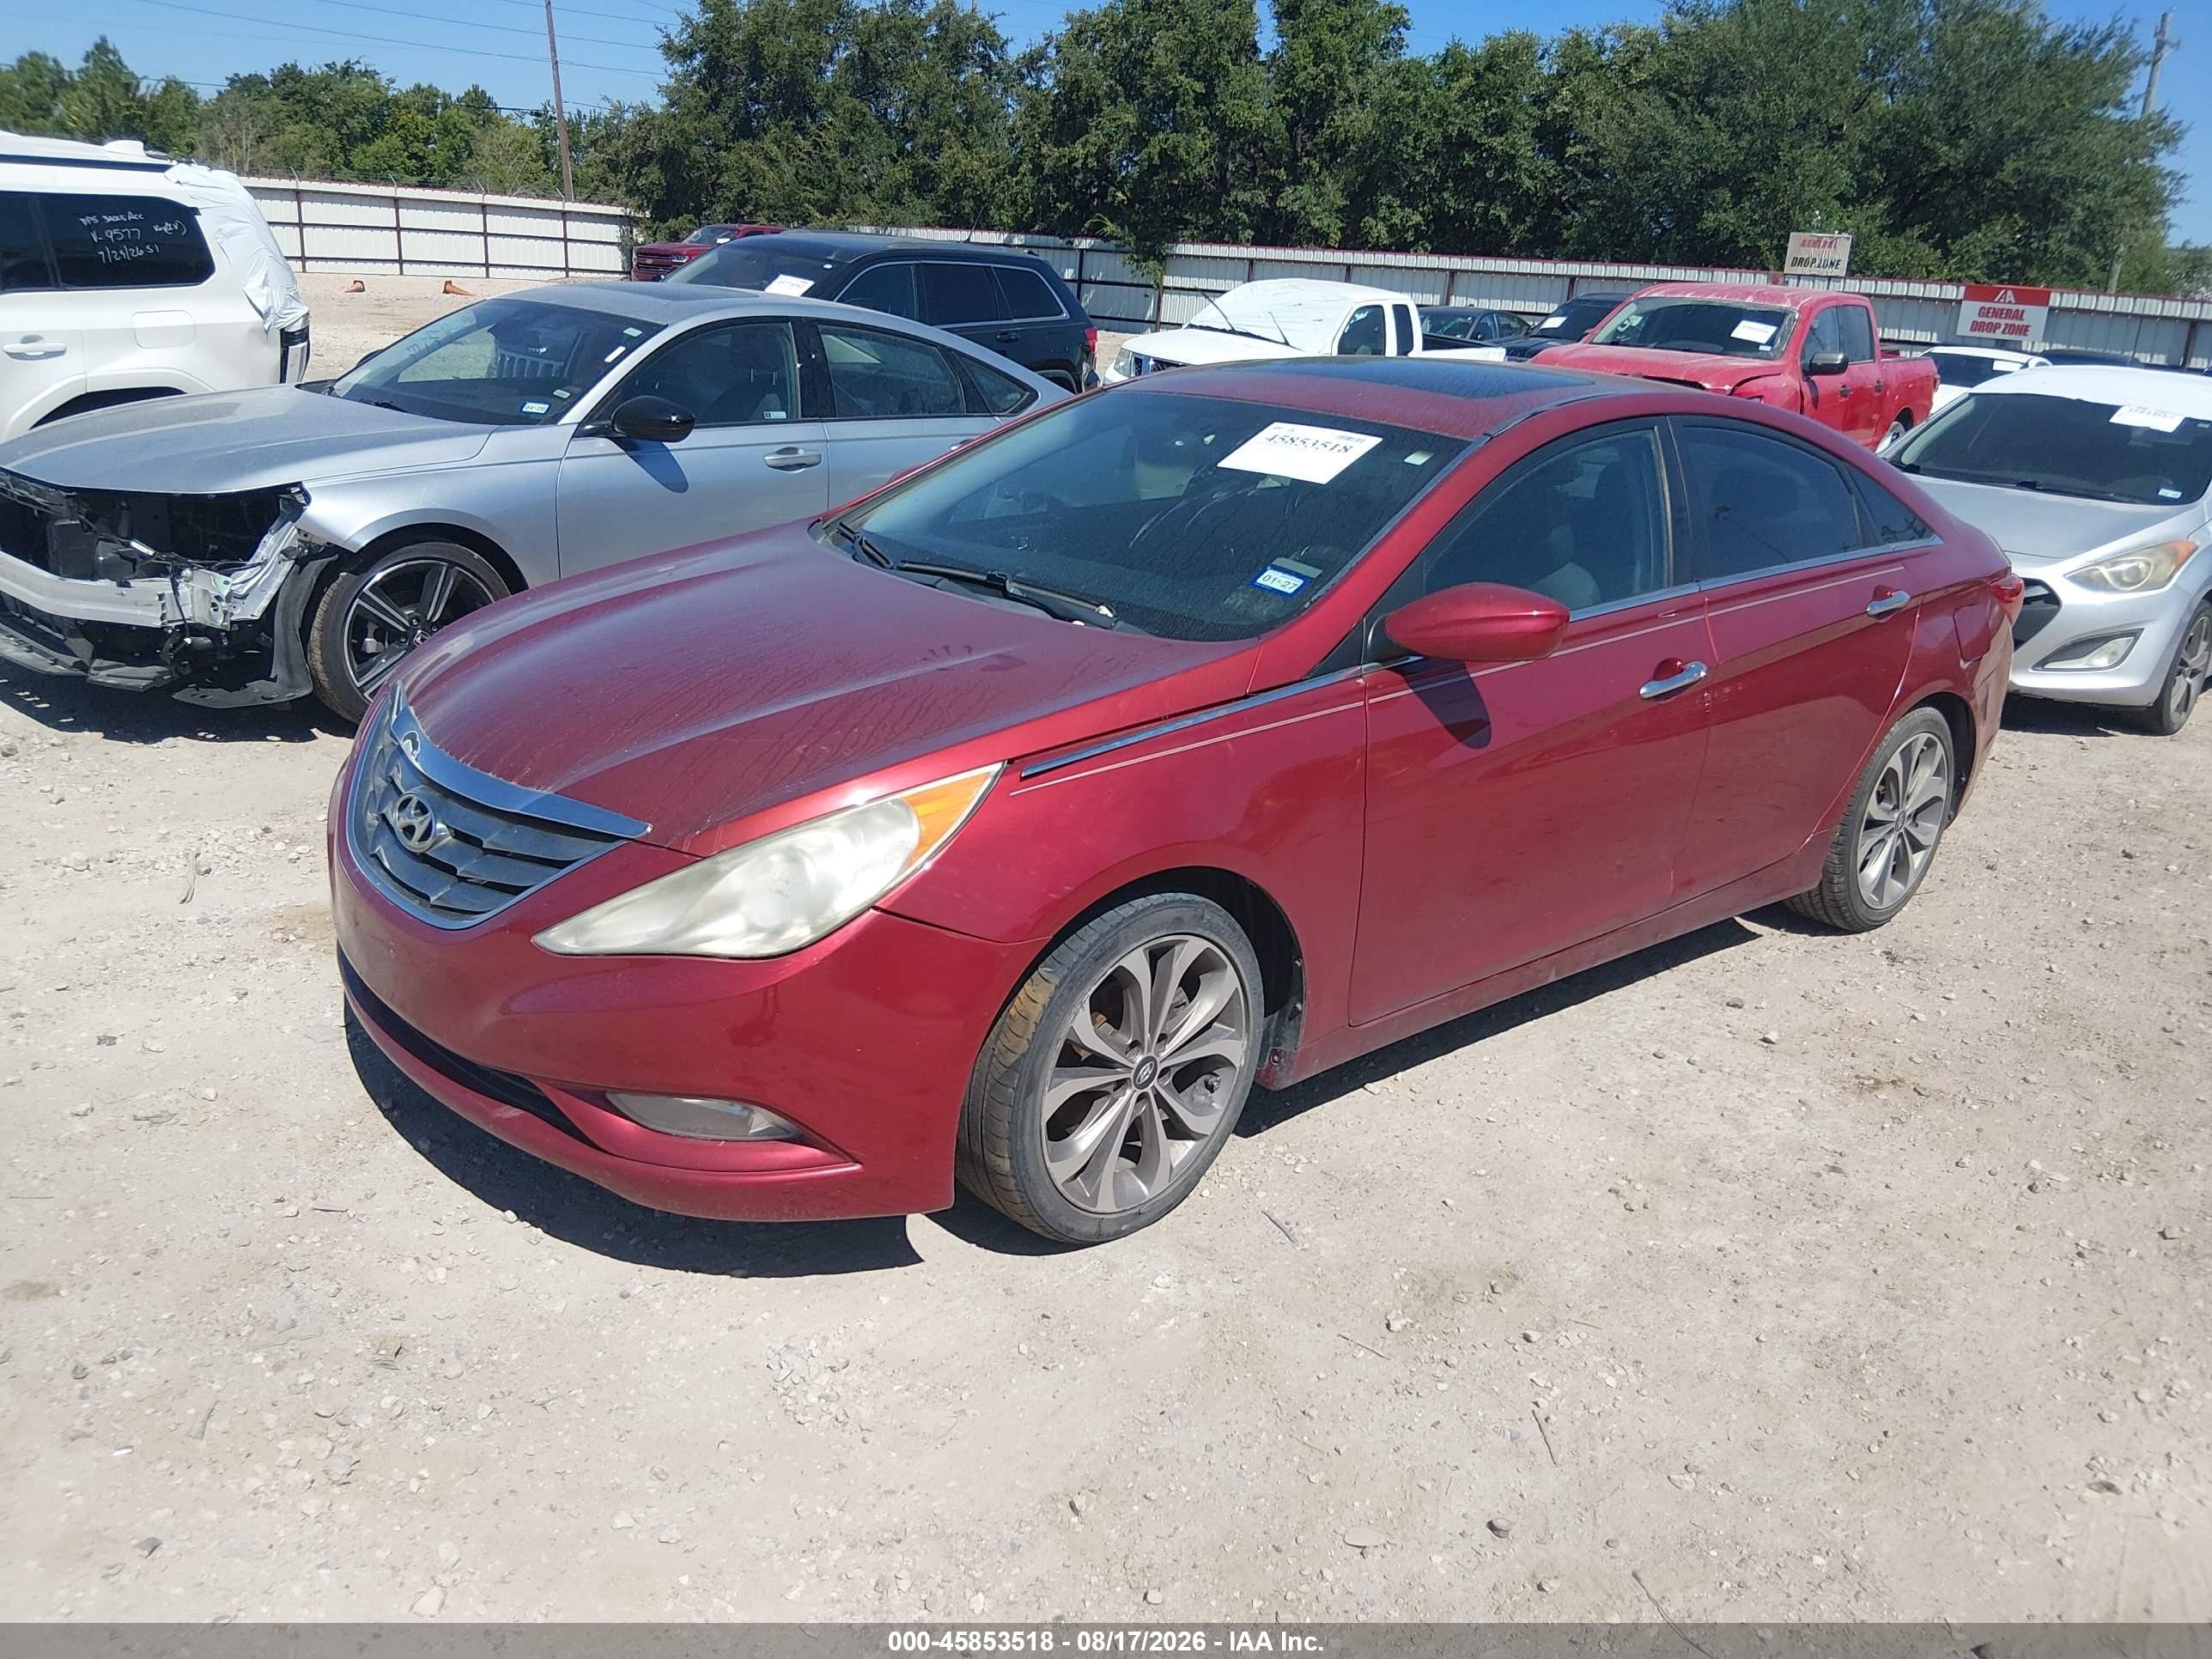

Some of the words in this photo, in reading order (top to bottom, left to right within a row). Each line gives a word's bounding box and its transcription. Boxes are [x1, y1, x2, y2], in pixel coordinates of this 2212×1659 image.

[1790, 256, 1817, 269] DROP
[1978, 306, 2026, 321] GENERAL
[1969, 320, 2002, 334] DROP
[2001, 323, 2033, 337] ZONE
